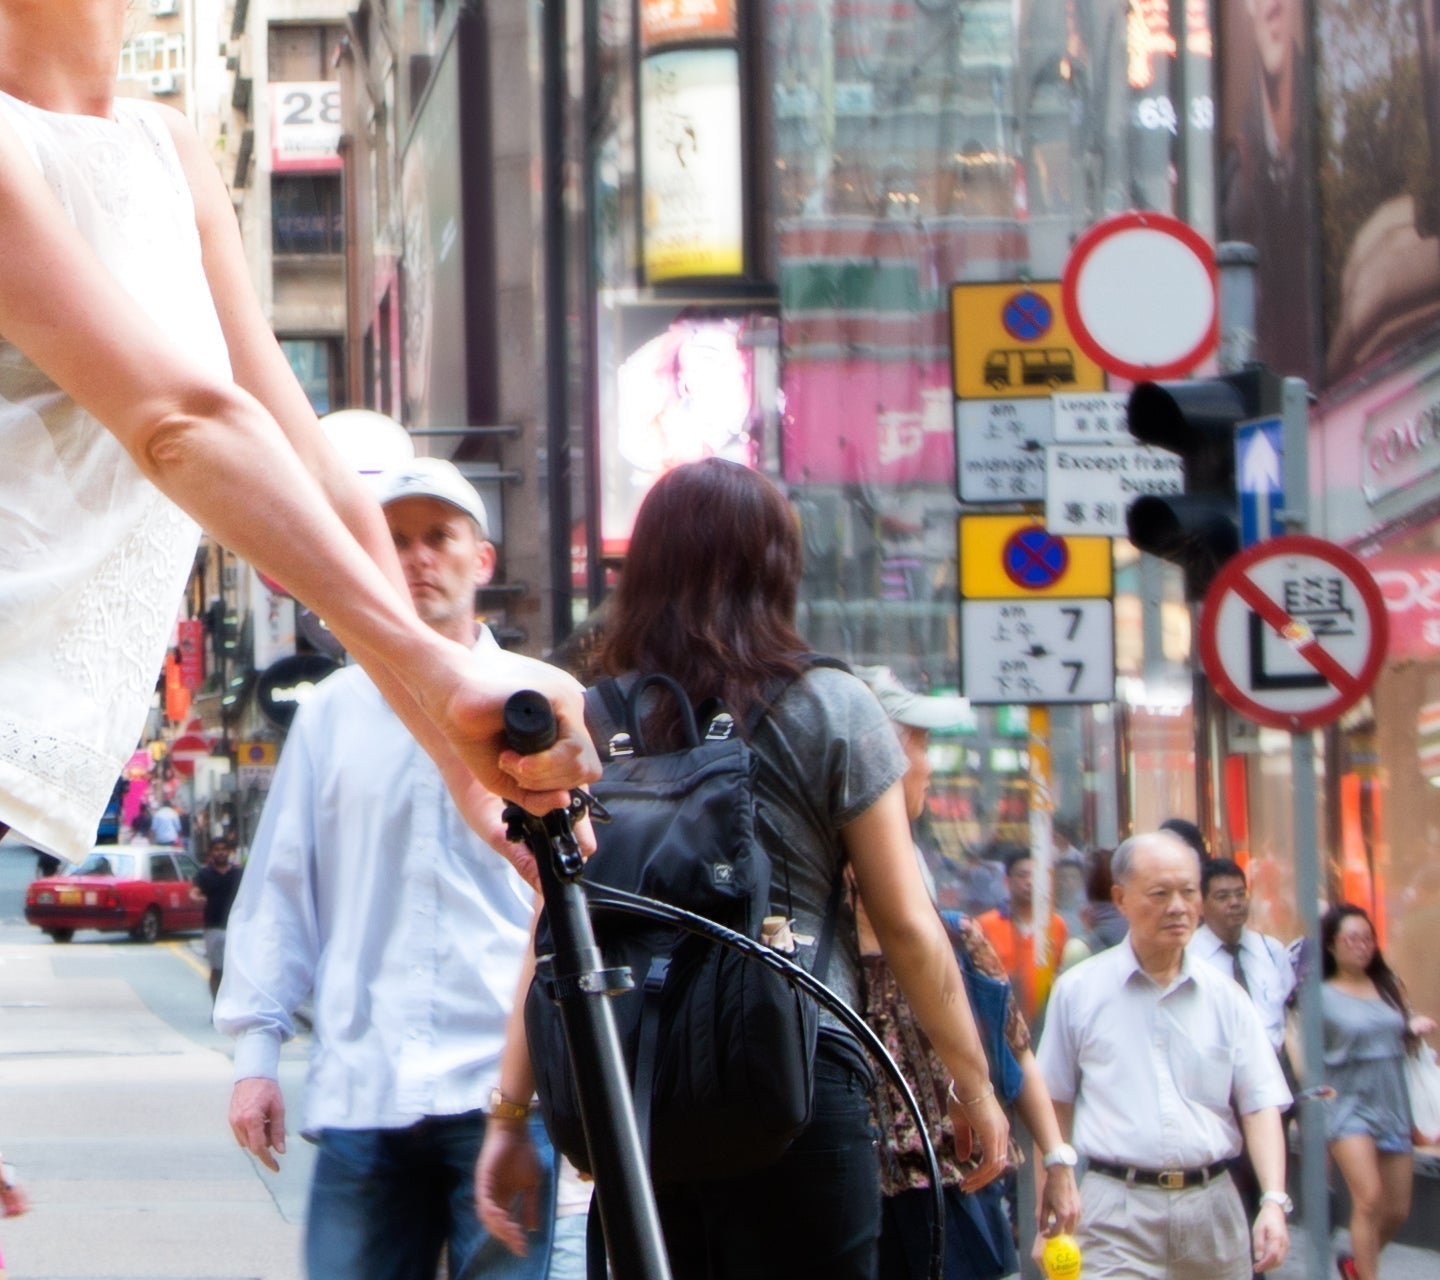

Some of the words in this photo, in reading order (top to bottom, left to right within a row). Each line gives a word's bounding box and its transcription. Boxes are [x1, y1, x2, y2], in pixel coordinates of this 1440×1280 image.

[989, 404, 1018, 417] am
[1061, 398, 1108, 418] Length
[968, 455, 1045, 474] midnight
[1056, 452, 1128, 475] Except
[1121, 477, 1181, 493] buses
[999, 606, 1027, 618] am
[1059, 607, 1083, 641] 7
[999, 659, 1028, 674] pm
[1060, 660, 1085, 694] 7
